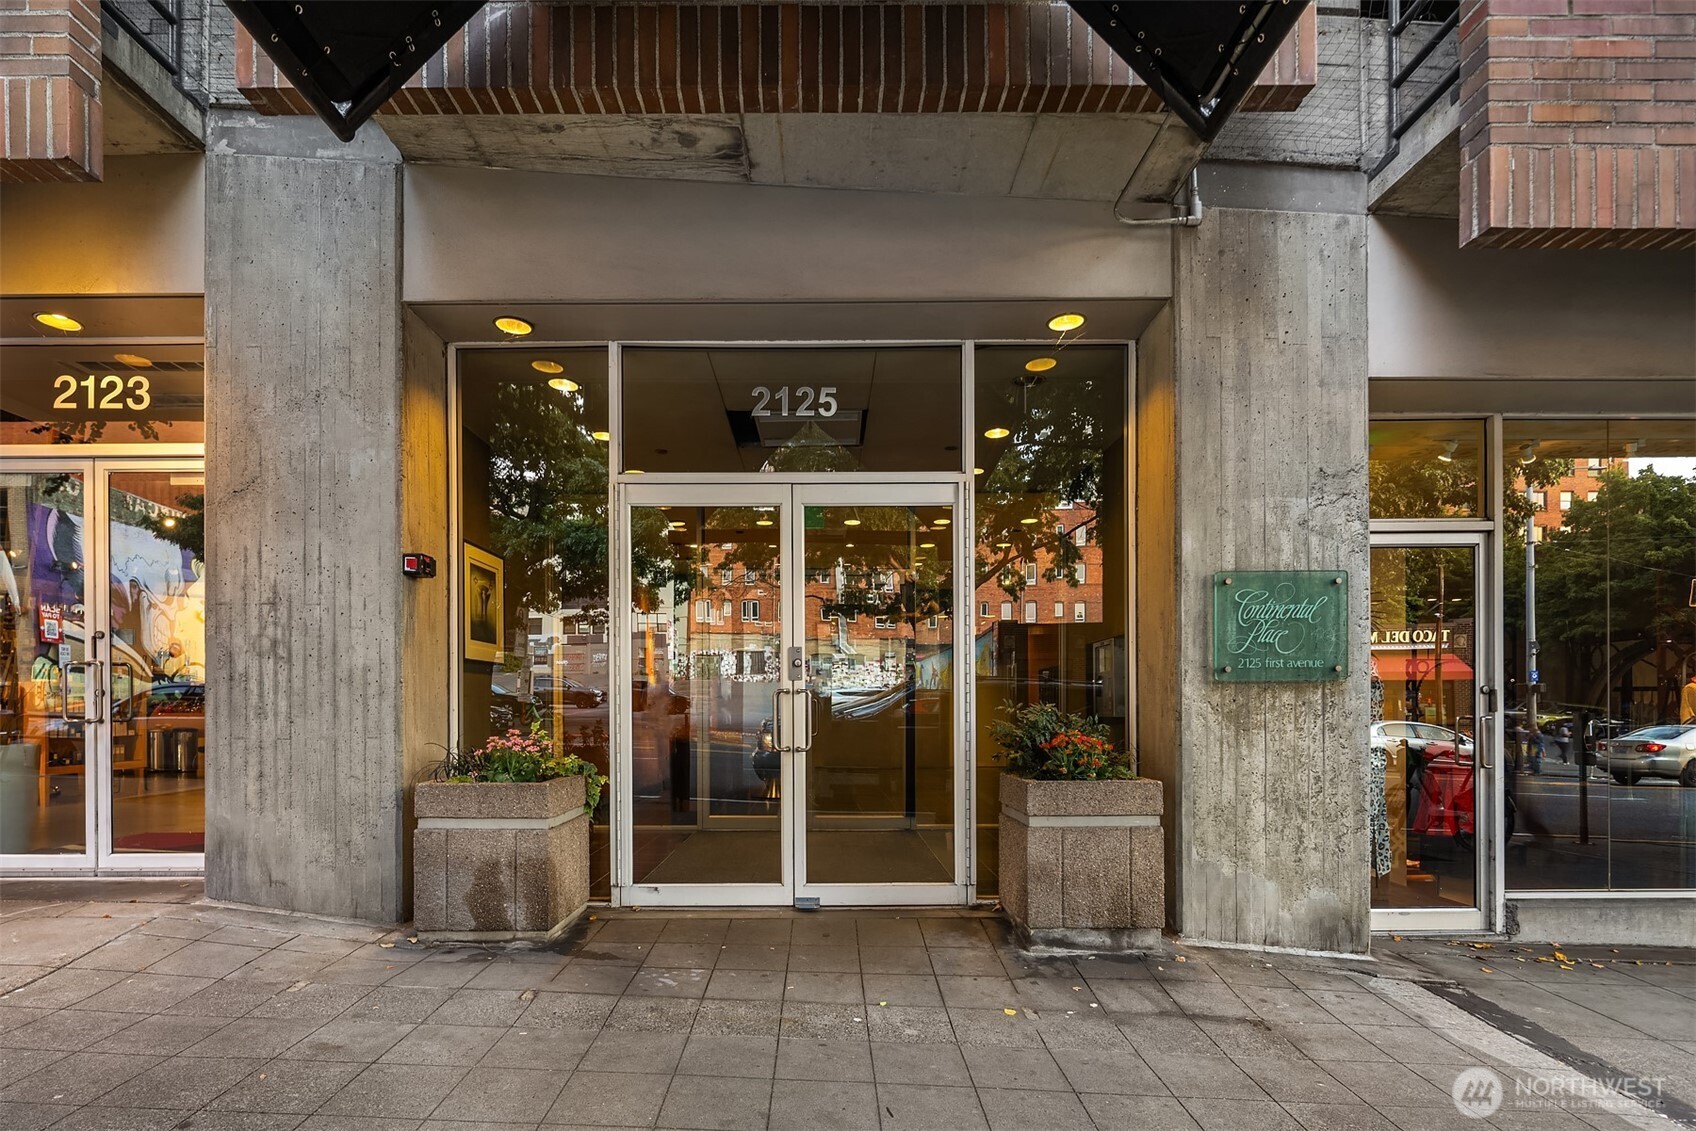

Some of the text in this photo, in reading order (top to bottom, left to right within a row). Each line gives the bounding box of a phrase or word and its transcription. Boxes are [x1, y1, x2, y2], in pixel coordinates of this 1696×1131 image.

[53, 374, 151, 411] 2123
[751, 386, 838, 417] 2125
[1235, 583, 1328, 627] Continental
[1227, 619, 1305, 654] Place
[1238, 657, 1325, 669] 2125 first avenue
